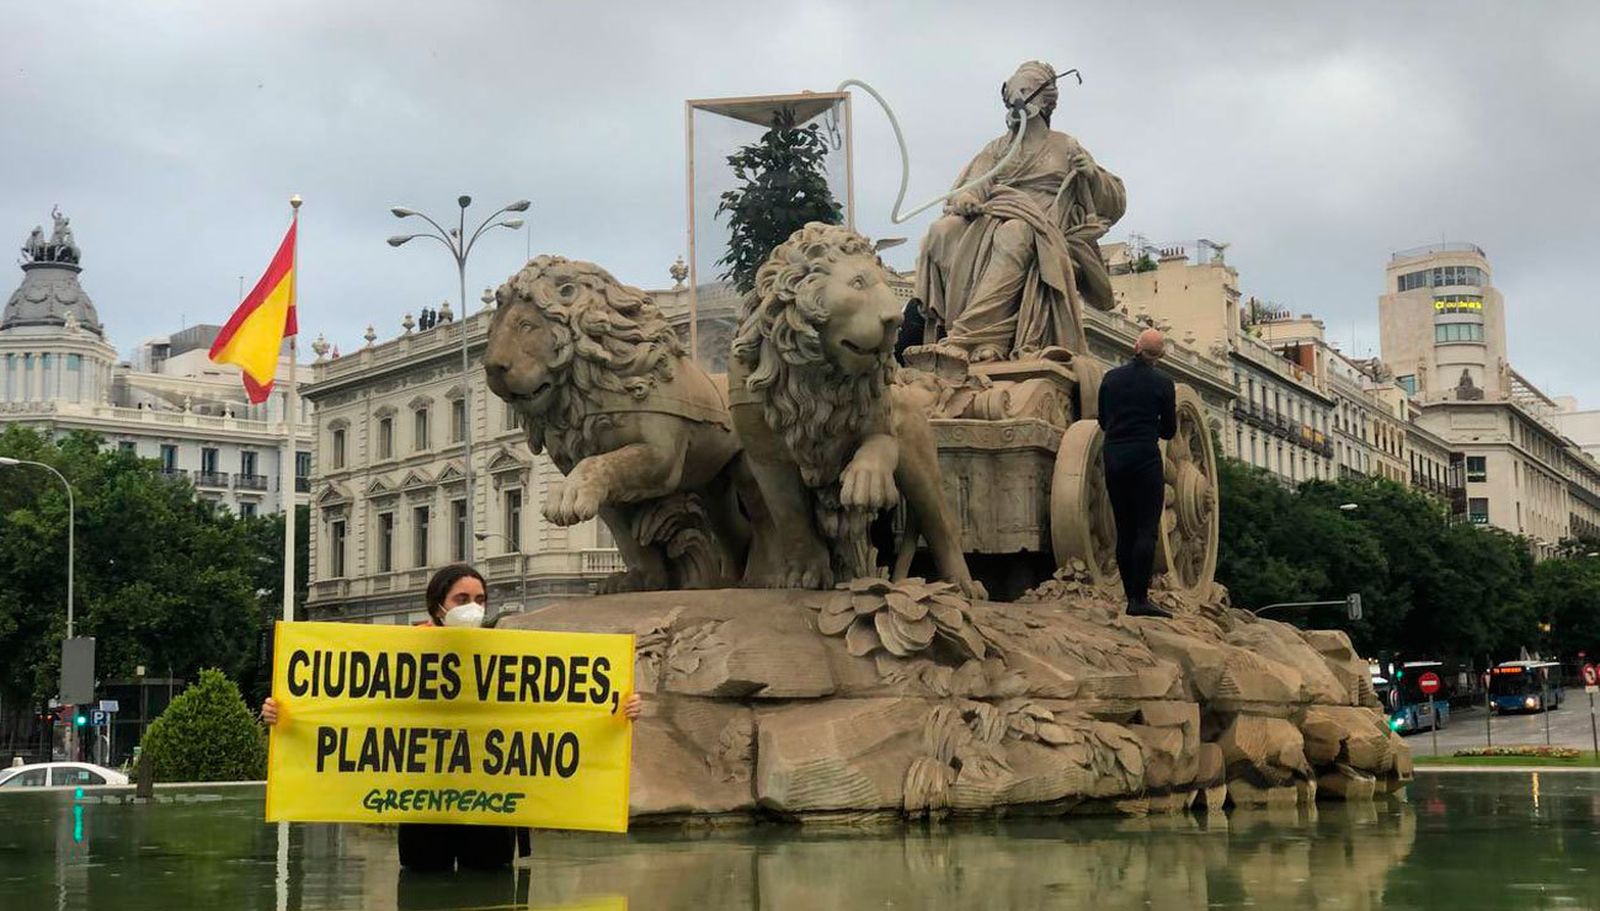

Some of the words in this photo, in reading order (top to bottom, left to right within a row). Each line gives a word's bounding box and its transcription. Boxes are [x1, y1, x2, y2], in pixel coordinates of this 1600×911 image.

[288, 650, 461, 701] CIUDADES
[474, 654, 618, 714] VERDES,
[94, 711, 105, 724] P
[317, 727, 472, 773] PLANETA
[483, 729, 579, 778] SANO
[363, 789, 526, 813] GREENPEACE
